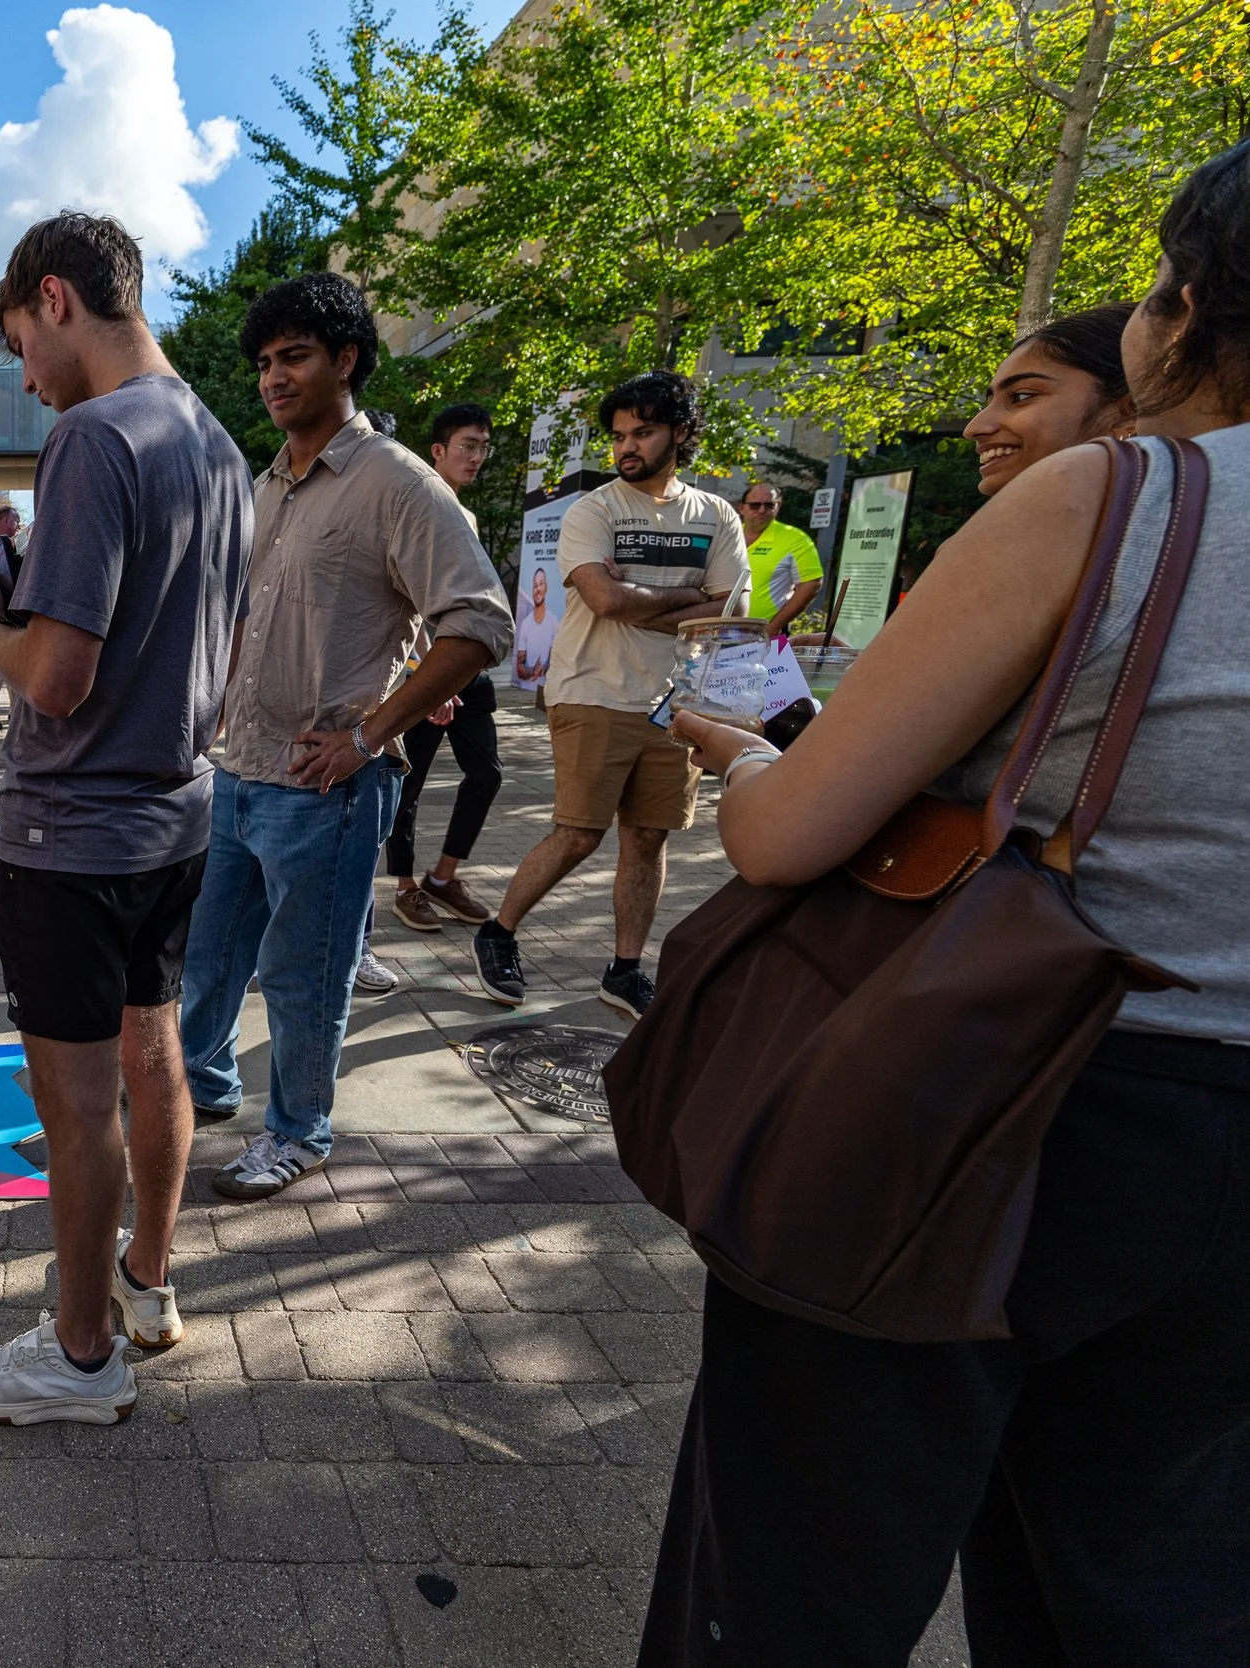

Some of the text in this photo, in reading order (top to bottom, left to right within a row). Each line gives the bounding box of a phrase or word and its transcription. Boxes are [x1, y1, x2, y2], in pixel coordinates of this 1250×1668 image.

[849, 526, 895, 540] Event Recording
[616, 534, 691, 547] RE-DEFINED
[860, 540, 878, 551] Notice
